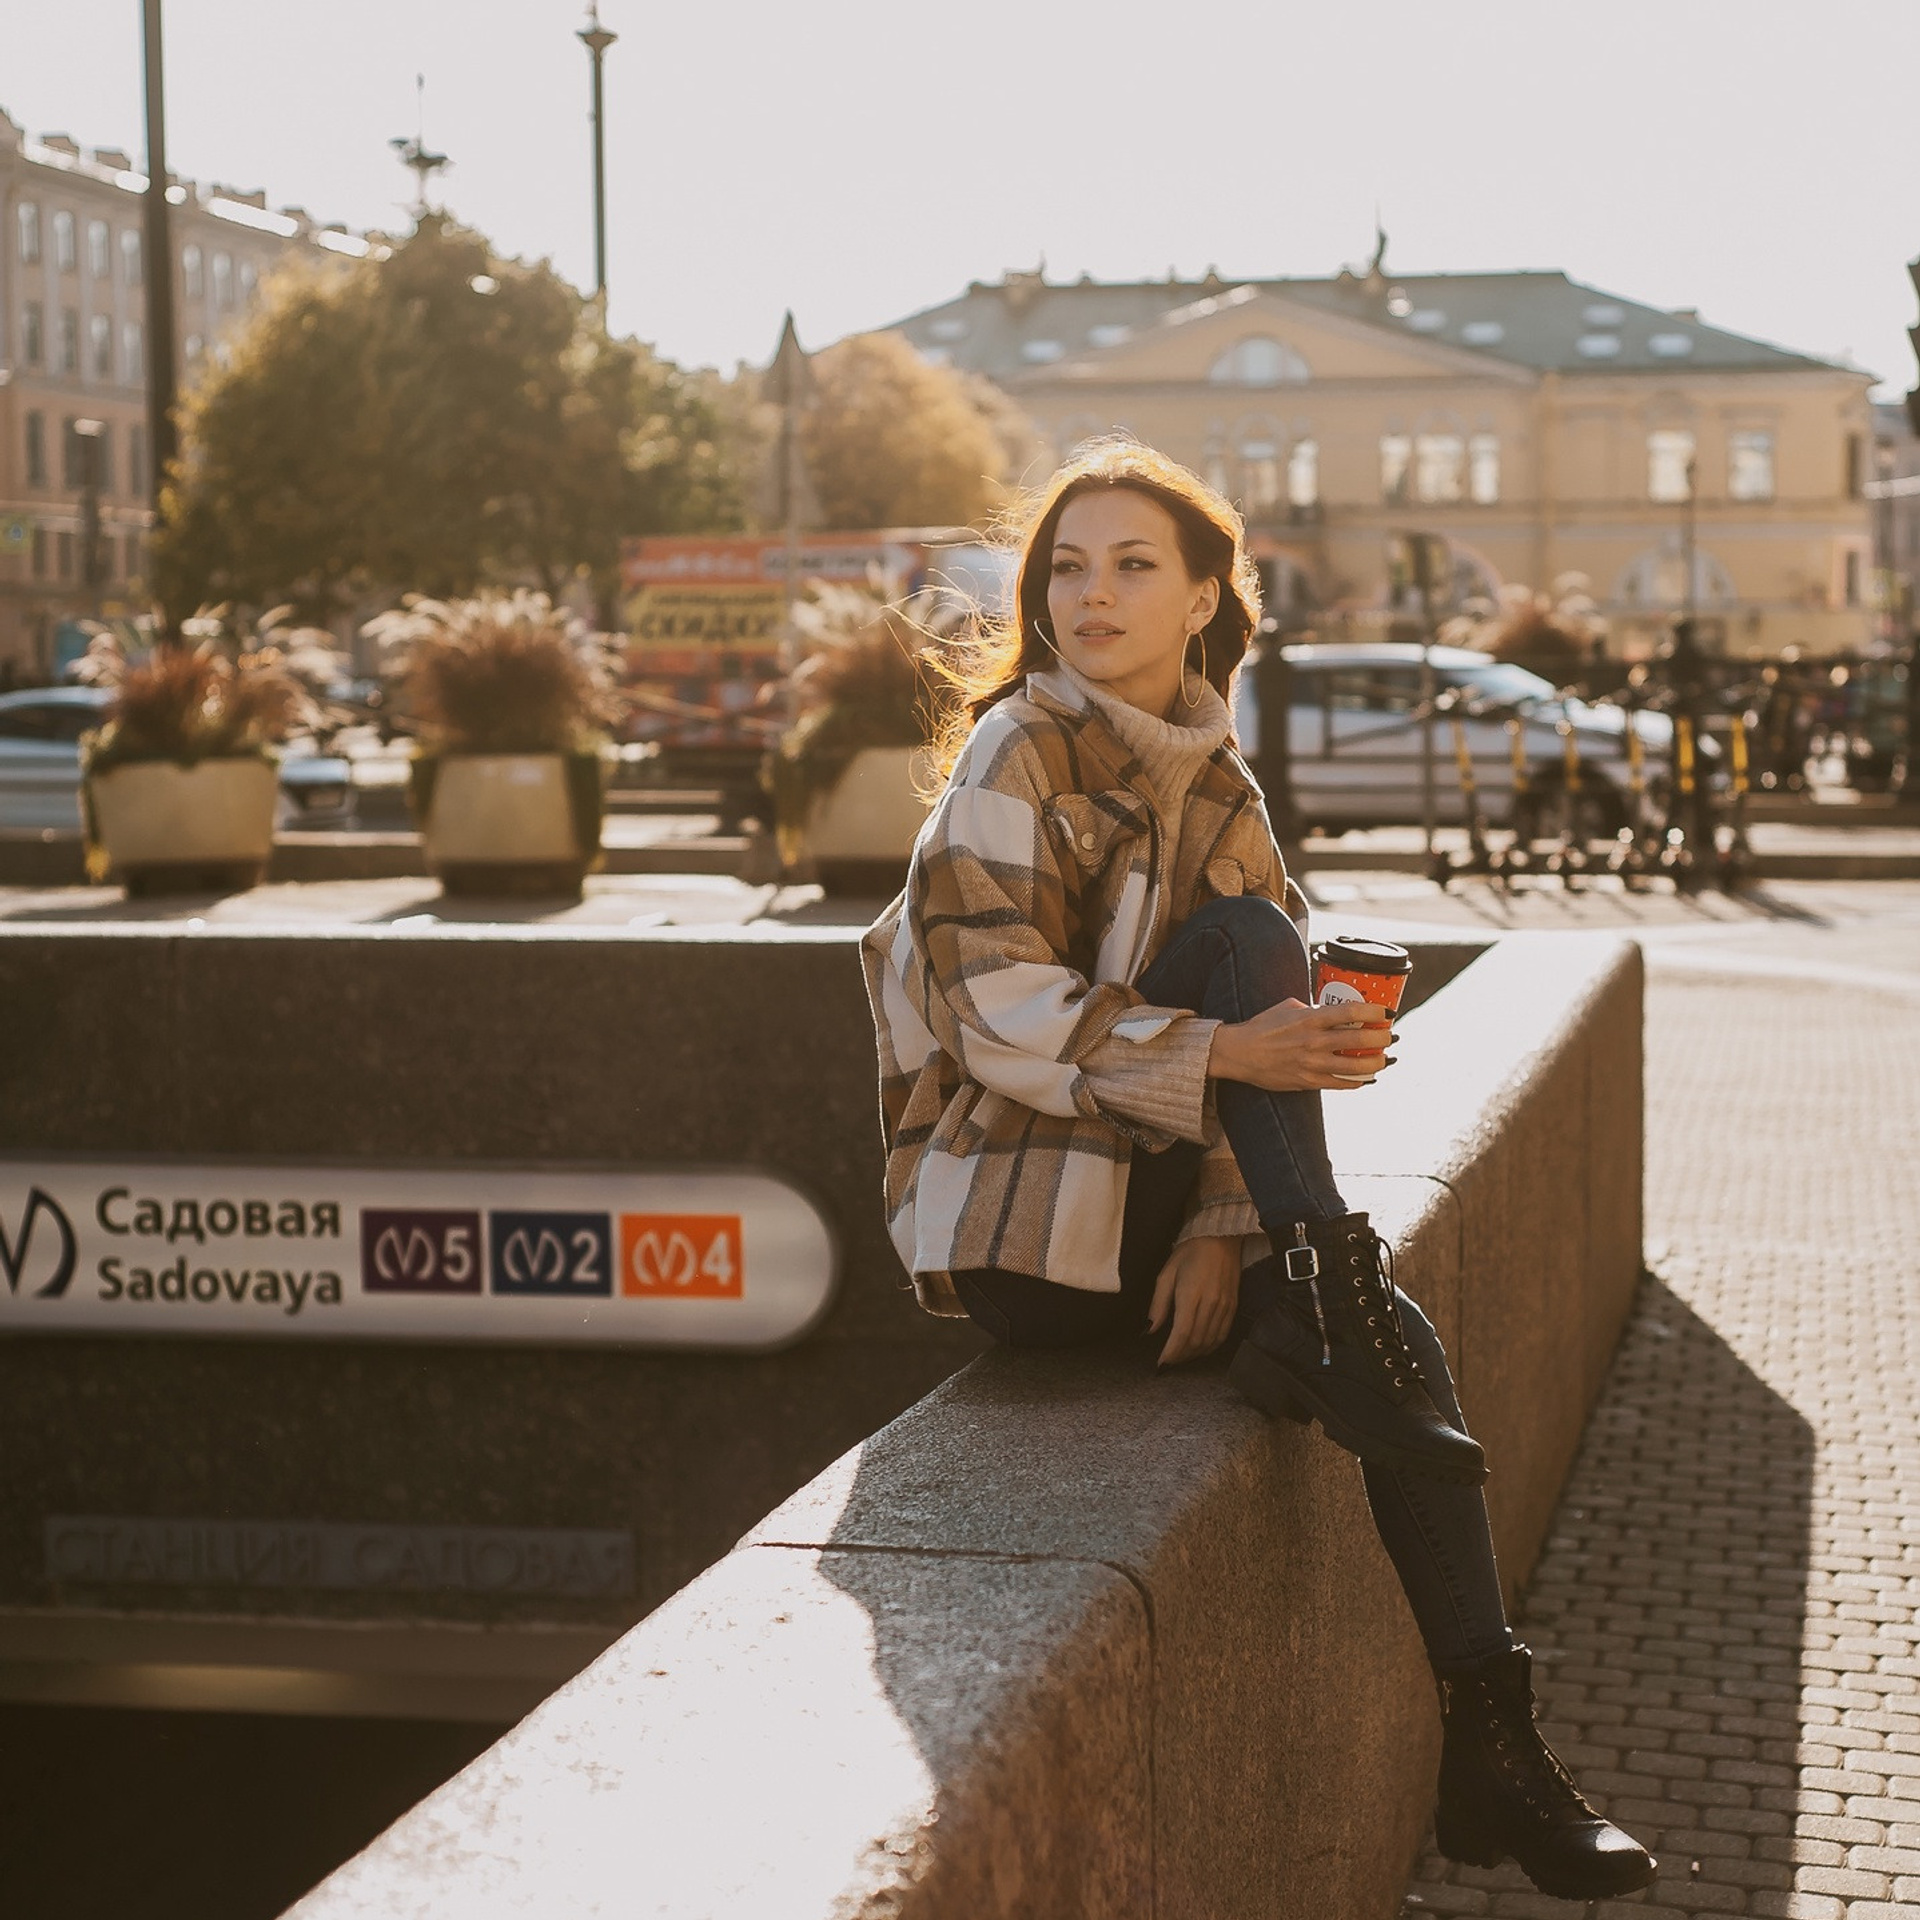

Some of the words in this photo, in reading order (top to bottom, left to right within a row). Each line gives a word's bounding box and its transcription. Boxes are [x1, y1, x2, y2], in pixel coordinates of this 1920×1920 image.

[96, 1186, 341, 1245] Садовая
[97, 1255, 343, 1316] Sadovaya
[52, 1527, 320, 1584] СТАНЦИЯ
